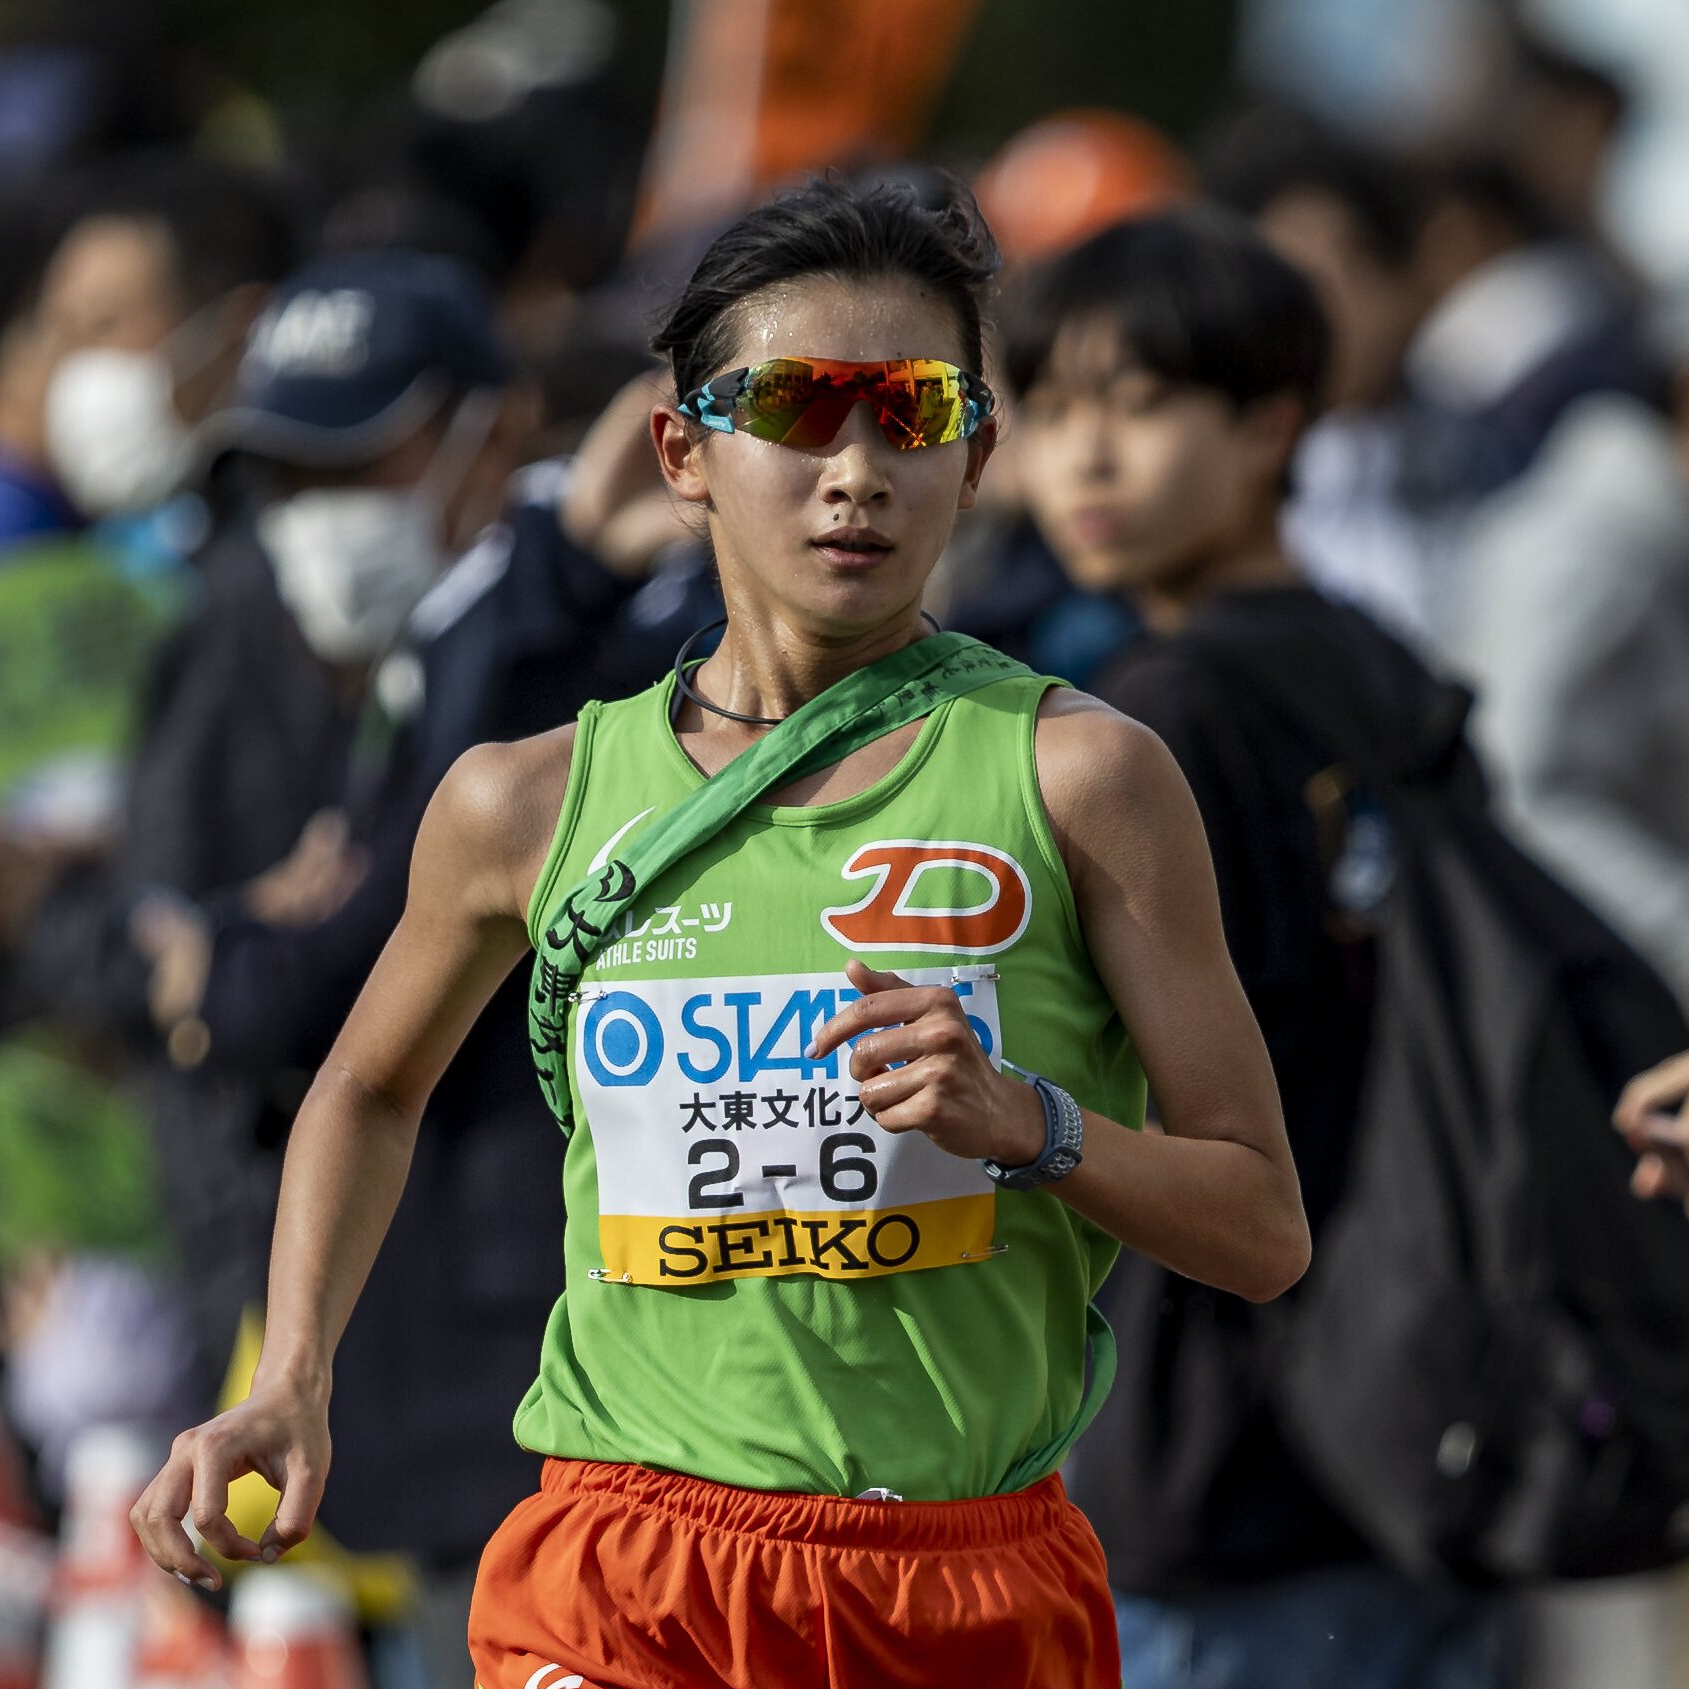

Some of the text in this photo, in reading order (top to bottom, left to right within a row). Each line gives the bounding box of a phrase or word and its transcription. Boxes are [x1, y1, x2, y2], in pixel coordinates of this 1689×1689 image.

[820, 838, 1033, 956] D
[595, 937, 698, 971] ATHLE SUITS
[687, 1132, 879, 1210] 2-6
[658, 1213, 921, 1278] SEIKO
